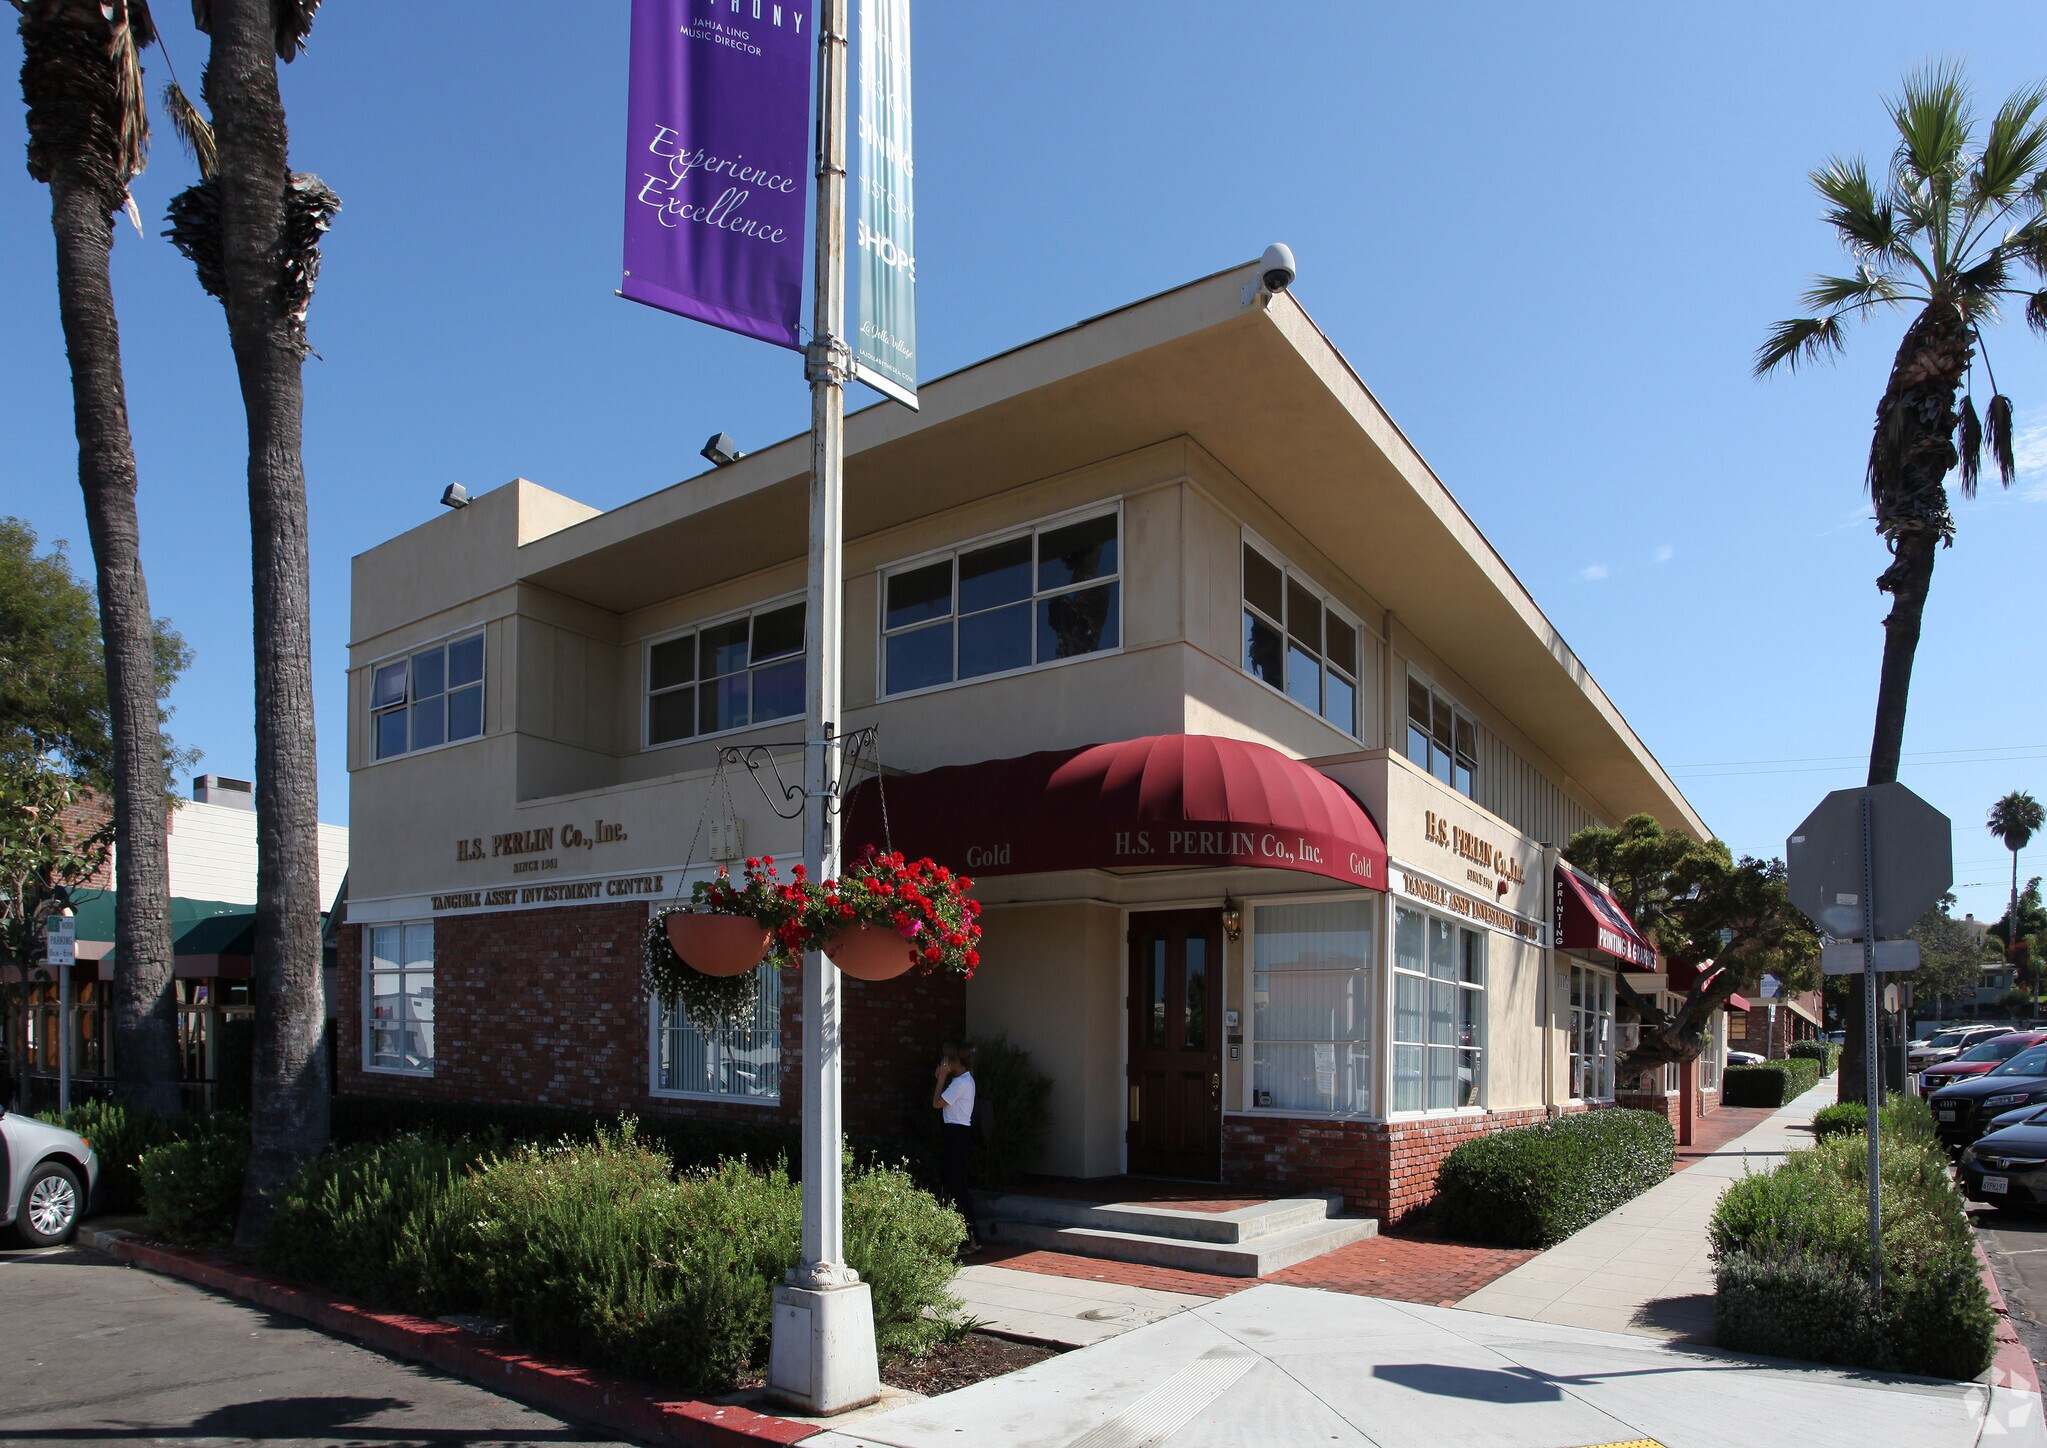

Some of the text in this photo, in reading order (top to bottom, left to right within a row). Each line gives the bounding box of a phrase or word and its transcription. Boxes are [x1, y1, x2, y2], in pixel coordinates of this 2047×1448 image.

[680, 25, 762, 56] MUSIC DIRECTOR
[693, 17, 750, 40] JAHJA LING
[648, 123, 797, 193] Experience
[858, 113, 914, 179] DINING
[638, 172, 787, 243] Excellence
[858, 172, 915, 222] HISTORY
[858, 217, 916, 283] SHOPS
[456, 838, 486, 861] H.S.
[491, 827, 554, 857] PERLIN
[966, 843, 1011, 868] Gold
[1115, 830, 1324, 864] H.S. PERLIN Co., Inc.
[1425, 810, 1449, 848] H.S.
[1452, 825, 1493, 868] PERLIN
[513, 861, 539, 873] SINCE
[1349, 852, 1372, 879] Gold
[431, 875, 664, 910] TANGIBLE ASSET INVESTMENT CENTRE
[1403, 873, 1448, 907] TANGIBLE
[1449, 893, 1471, 915] ASSET
[1555, 882, 1564, 945] PRINTING
[50, 936, 73, 946] PARKING
[1599, 928, 1626, 957] PRINTING
